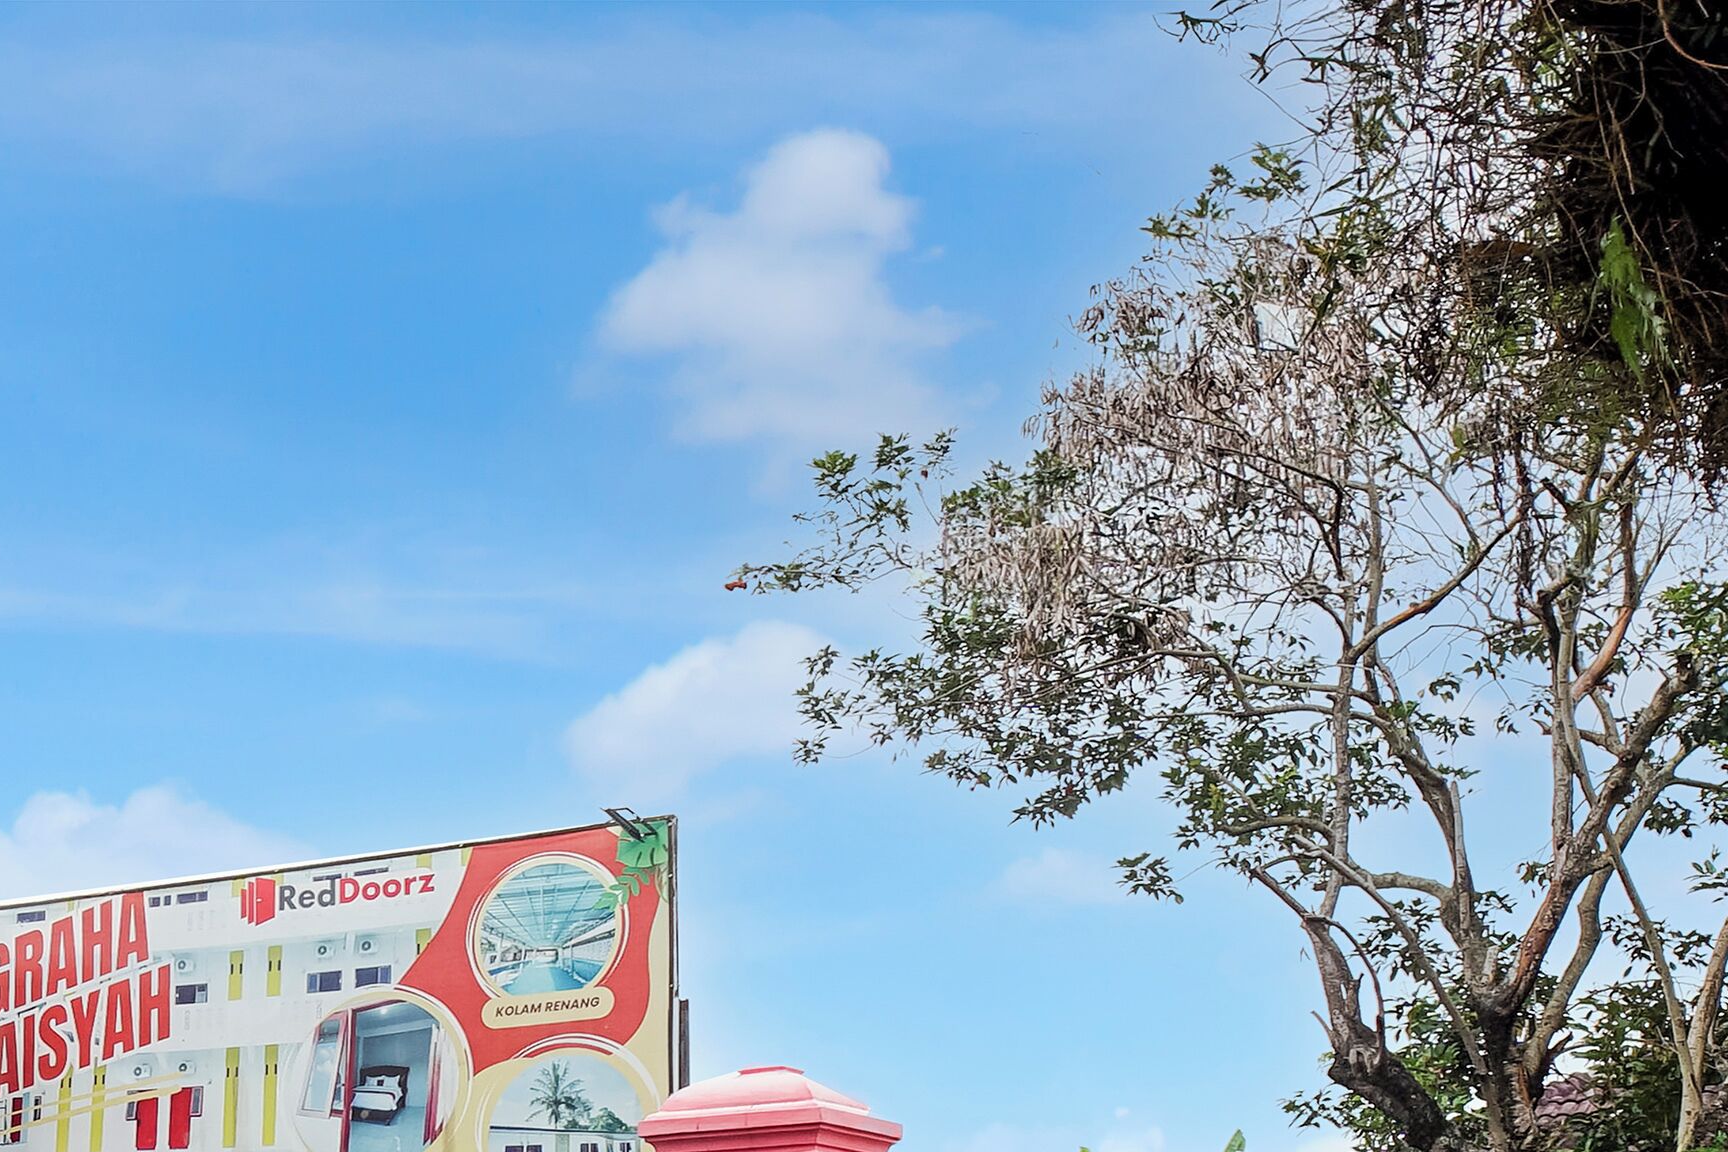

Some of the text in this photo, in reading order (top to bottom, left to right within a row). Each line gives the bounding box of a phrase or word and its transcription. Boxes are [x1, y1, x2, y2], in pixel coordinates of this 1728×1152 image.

[279, 873, 435, 911] RedDoorz
[495, 997, 600, 1017] KOLAM RENANG
